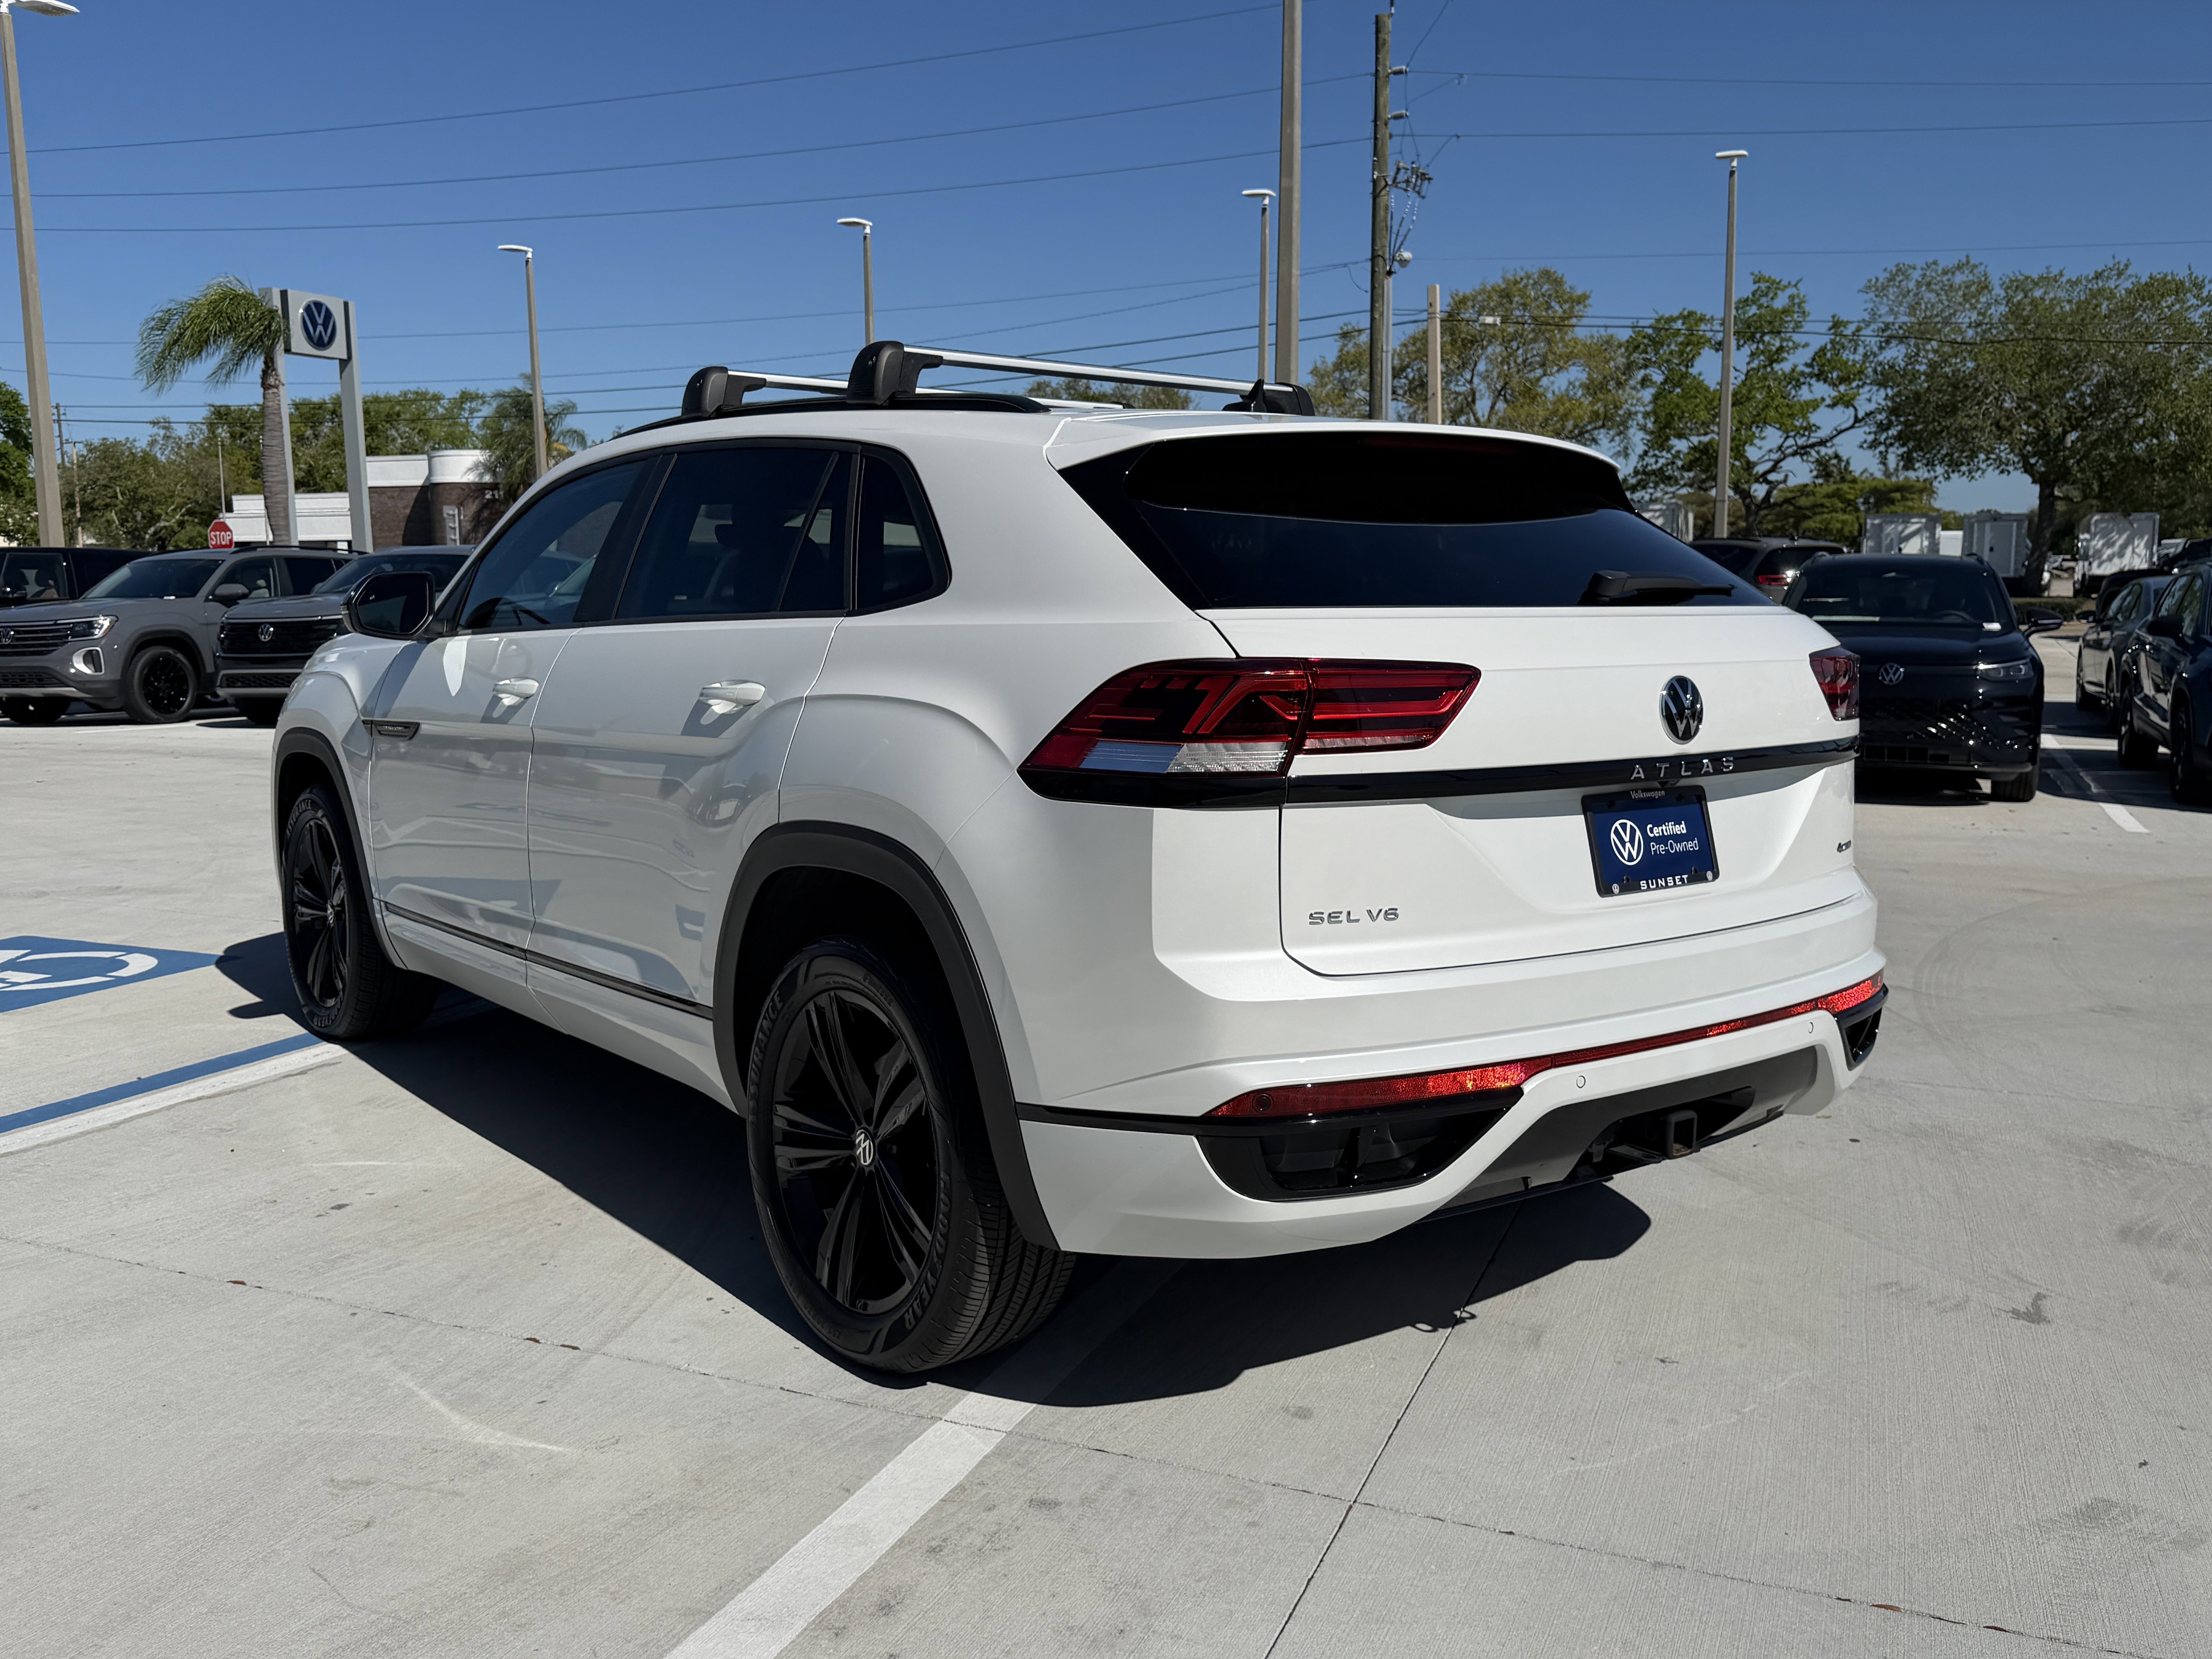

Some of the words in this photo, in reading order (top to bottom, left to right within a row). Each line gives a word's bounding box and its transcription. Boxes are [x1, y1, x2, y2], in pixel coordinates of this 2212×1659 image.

[210, 531, 232, 545] STOP
[1630, 756, 1734, 780] ATLAS
[1630, 789, 1665, 799] Volkswagen
[1647, 821, 1686, 837] Certified
[1650, 837, 1699, 855] Pre-Owned
[1640, 874, 1689, 890] SUNSET
[1309, 908, 1361, 925] SEL
[1366, 906, 1399, 922] V6
